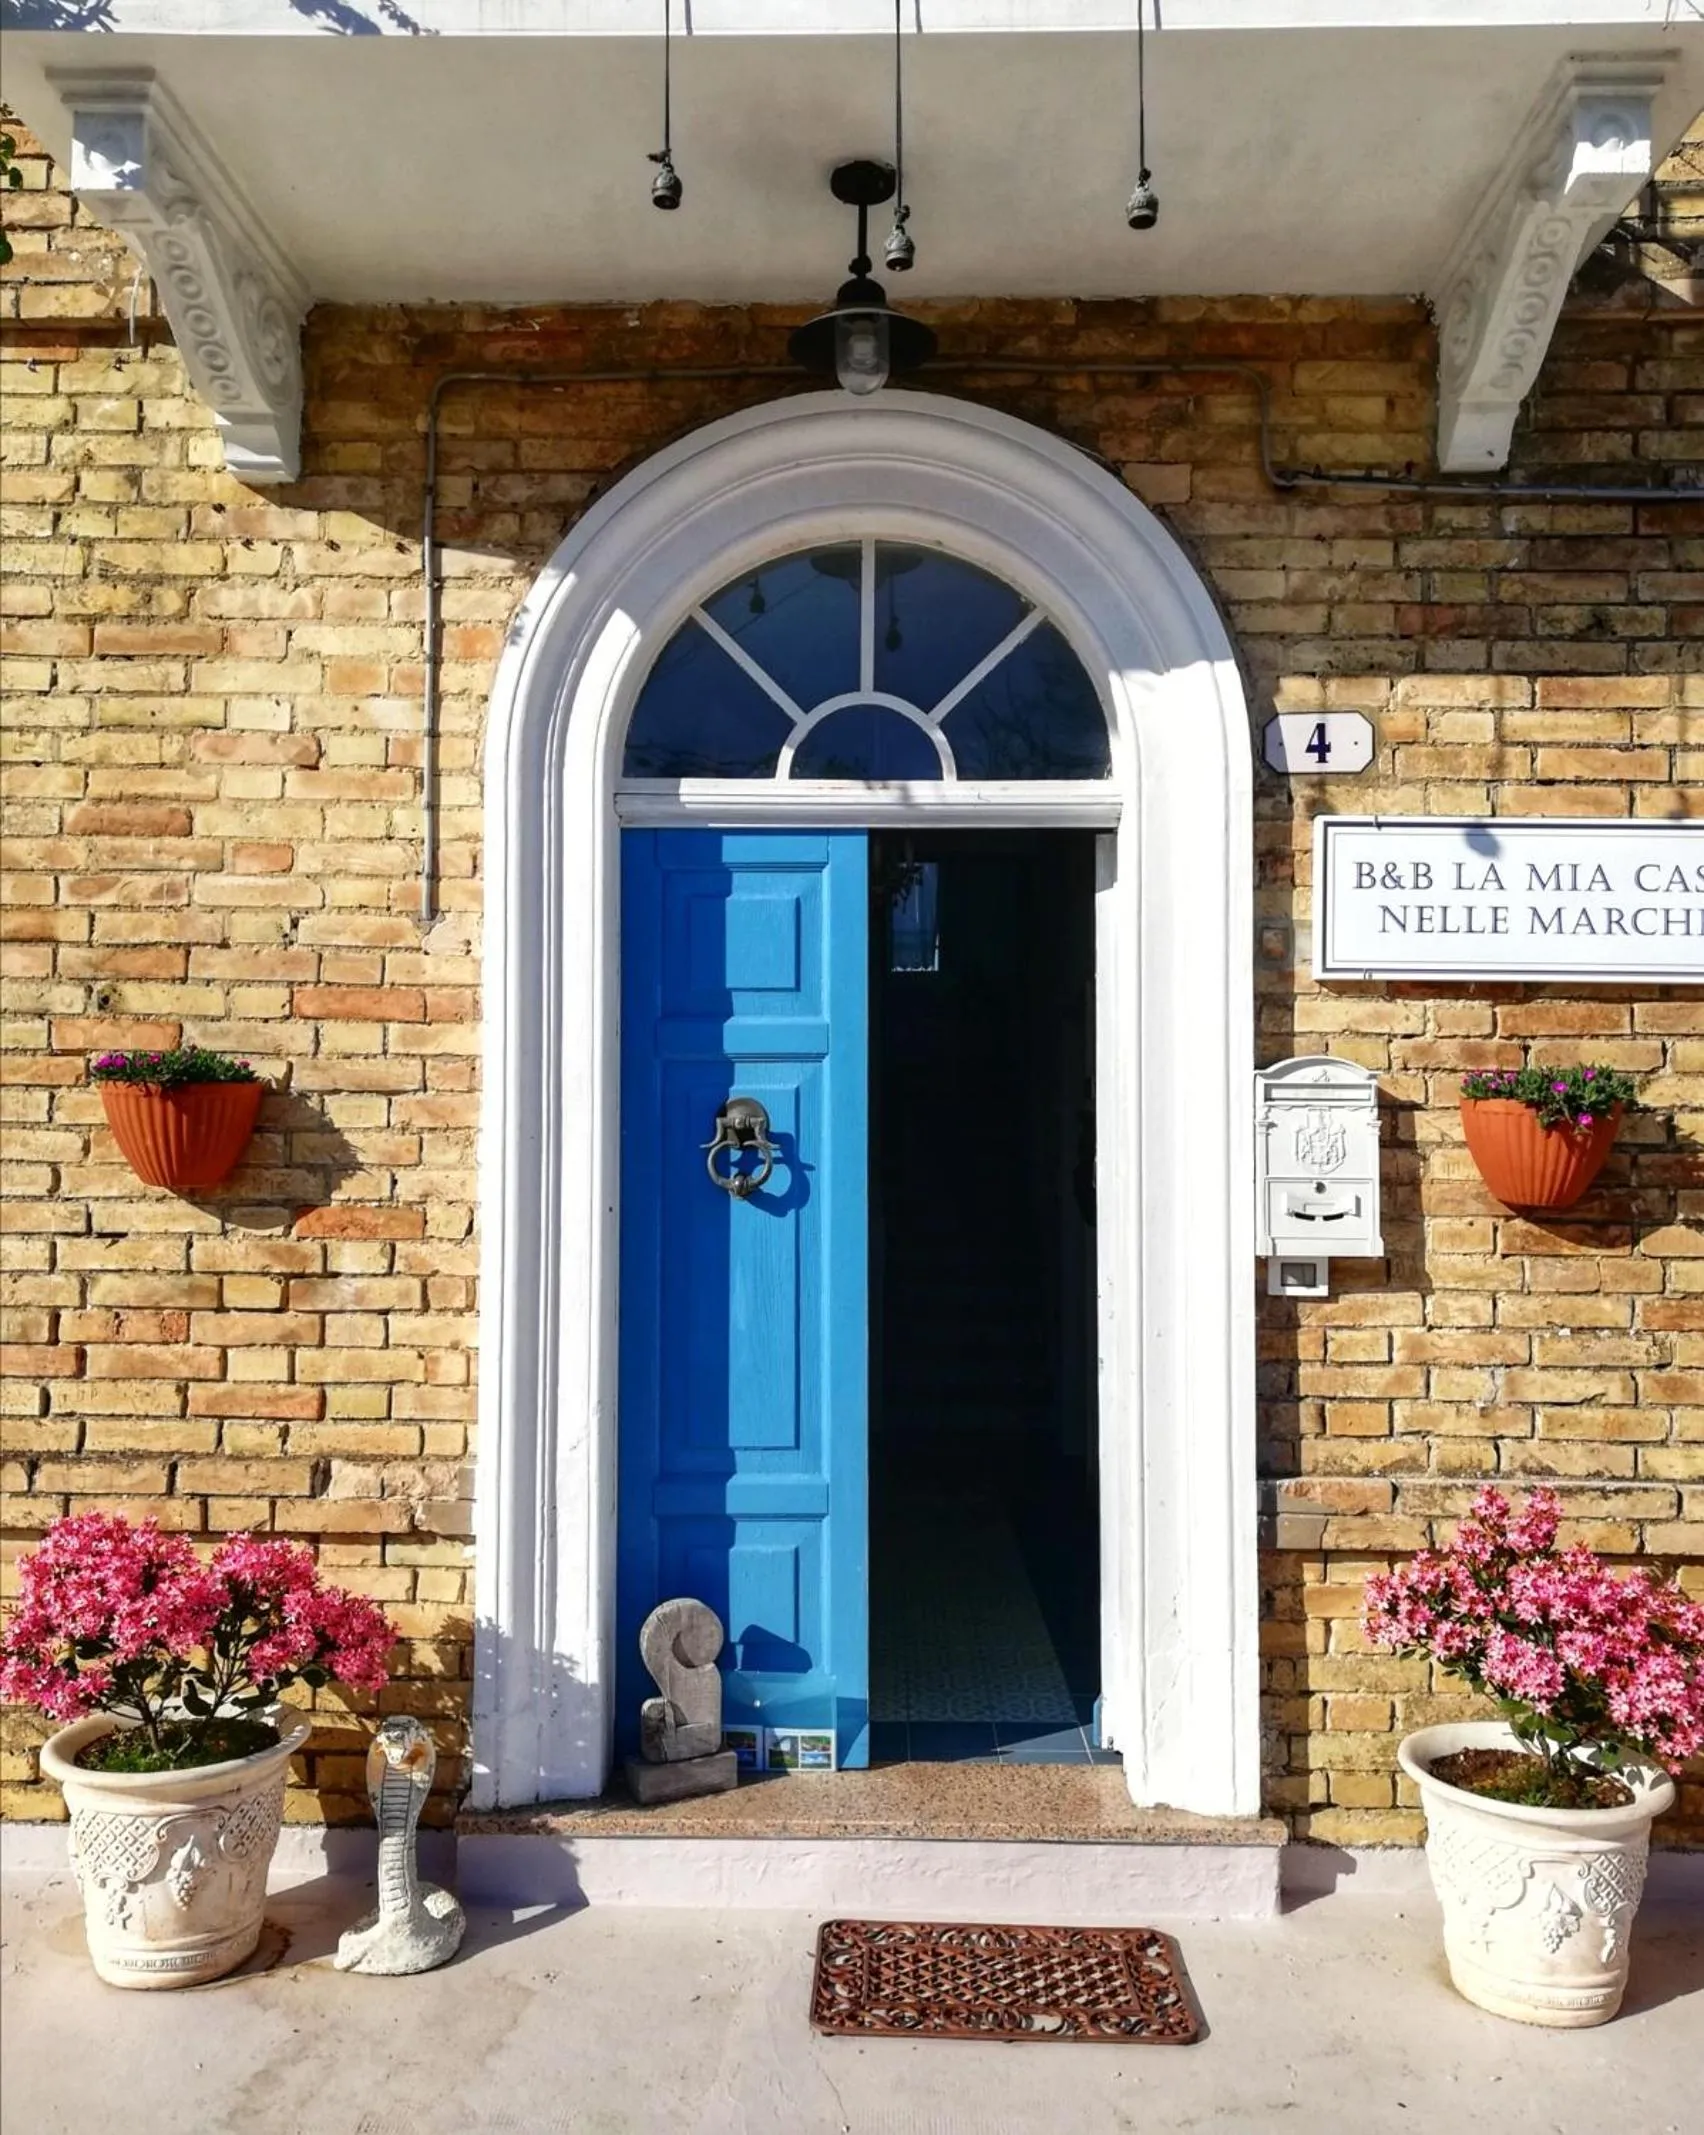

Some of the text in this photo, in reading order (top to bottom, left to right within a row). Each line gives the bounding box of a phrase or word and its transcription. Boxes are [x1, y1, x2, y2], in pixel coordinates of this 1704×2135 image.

[1304, 722, 1332, 764] 4
[1353, 861, 1434, 890] B&B
[1452, 862, 1507, 891] LA
[1526, 863, 1614, 892] MIA
[1378, 904, 1510, 934] NELLE
